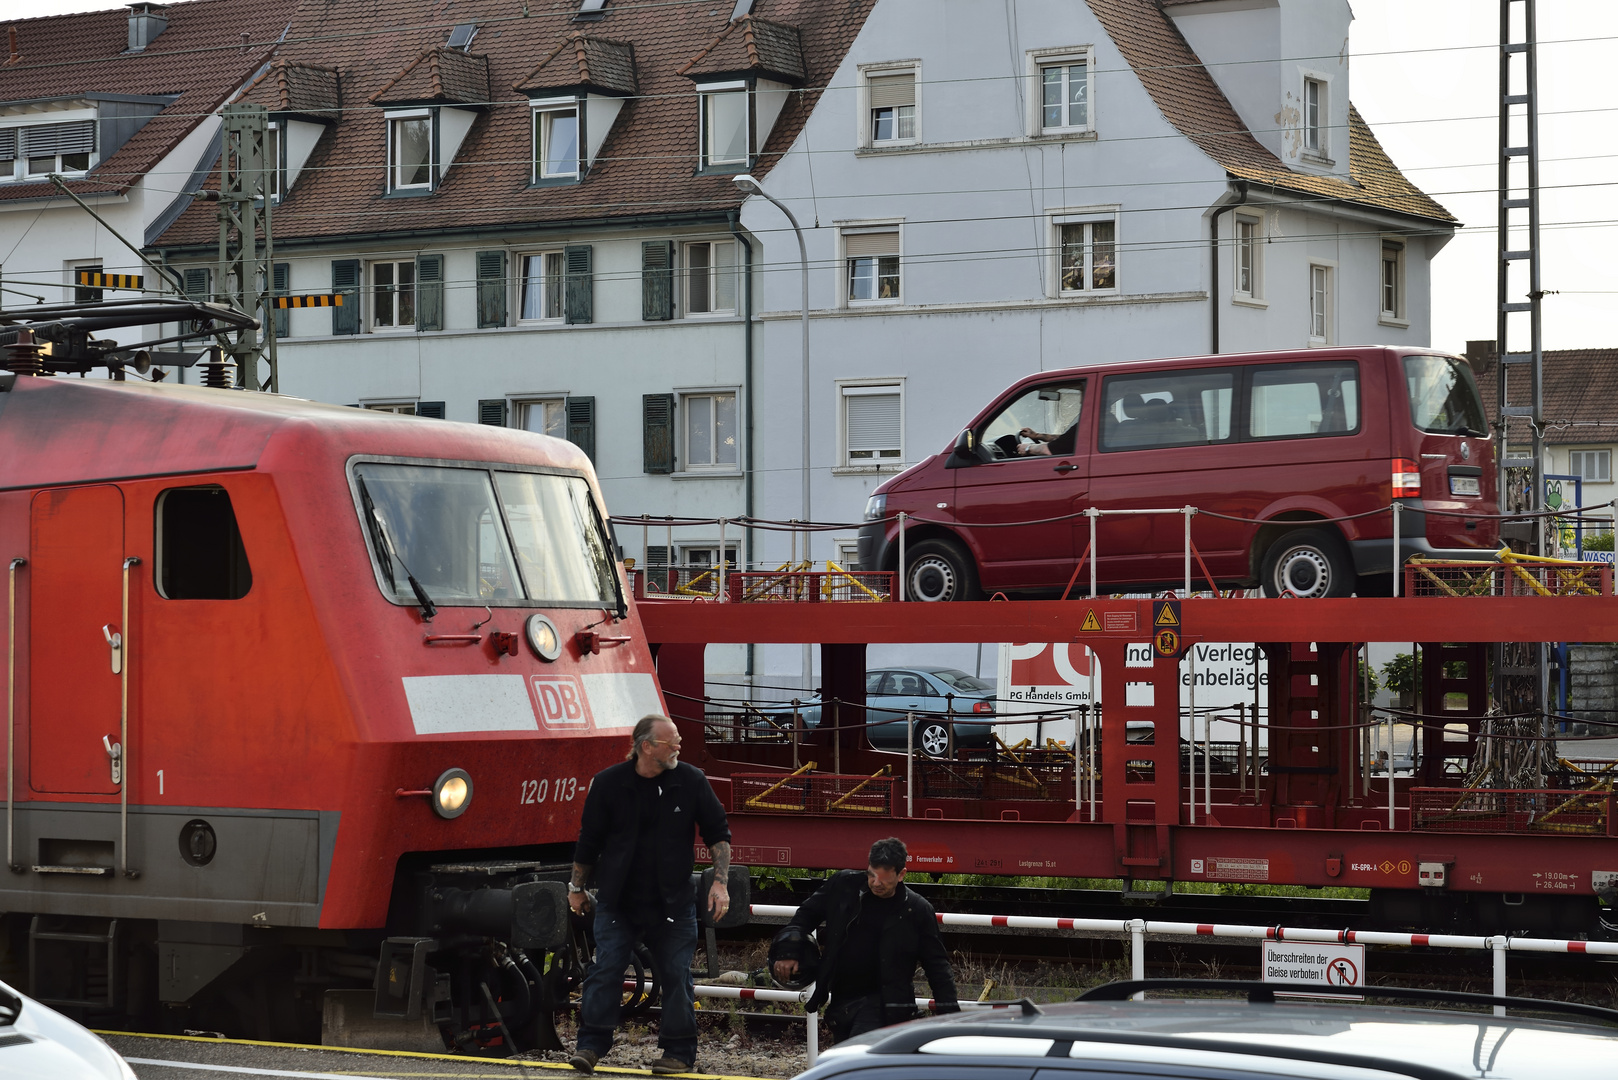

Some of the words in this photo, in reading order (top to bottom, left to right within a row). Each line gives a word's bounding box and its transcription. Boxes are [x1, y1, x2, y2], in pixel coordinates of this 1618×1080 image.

[1584, 551, 1615, 563] WÄSC
[539, 683, 581, 720] DB
[1010, 691, 1022, 700] PG
[1025, 691, 1063, 700] Handels
[156, 769, 164, 795] 1
[520, 778, 549, 805] 120
[553, 776, 595, 802] 113-
[916, 855, 943, 863] Fernverkehr
[946, 856, 954, 864] AG
[1018, 860, 1043, 869] Lastgrenze
[1543, 881, 1568, 889] 26.40m
[1267, 949, 1315, 964] Überschreiten
[1316, 953, 1328, 965] der
[1267, 966, 1288, 978] Gleise
[1290, 967, 1319, 980] verboten
